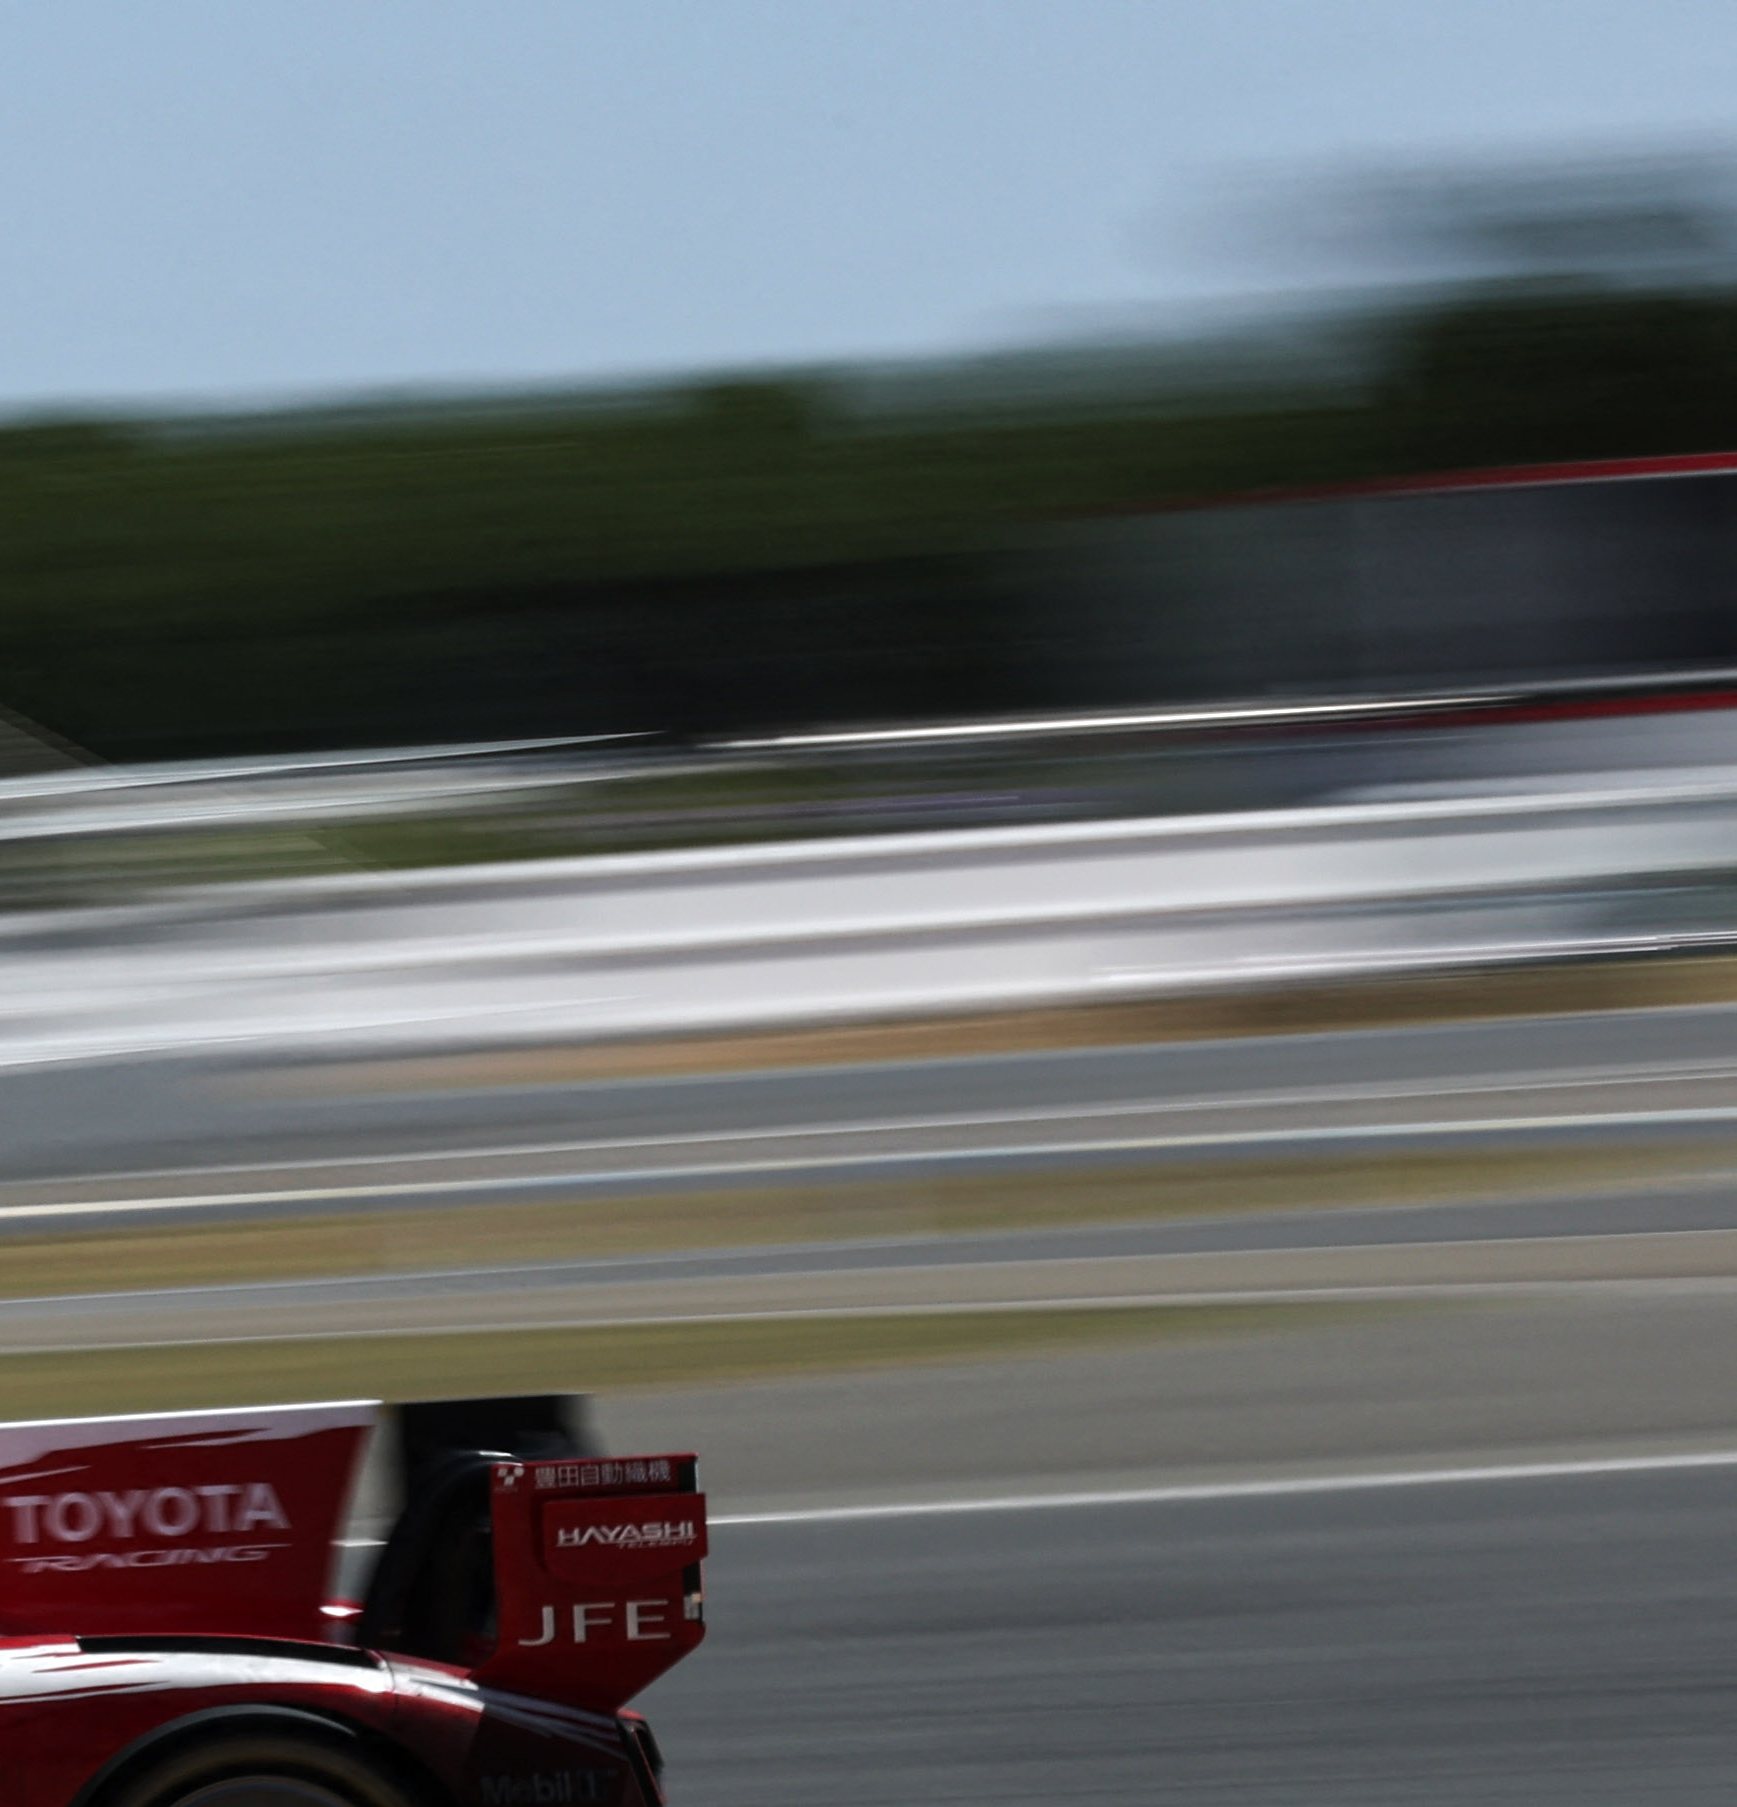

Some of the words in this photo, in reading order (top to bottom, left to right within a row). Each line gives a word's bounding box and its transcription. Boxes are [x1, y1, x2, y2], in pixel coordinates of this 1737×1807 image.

[1, 1482, 293, 1544] TOYOTA
[556, 1520, 697, 1548] HAYASHI
[3, 1543, 293, 1574] RACING
[518, 1598, 671, 1646] JFE
